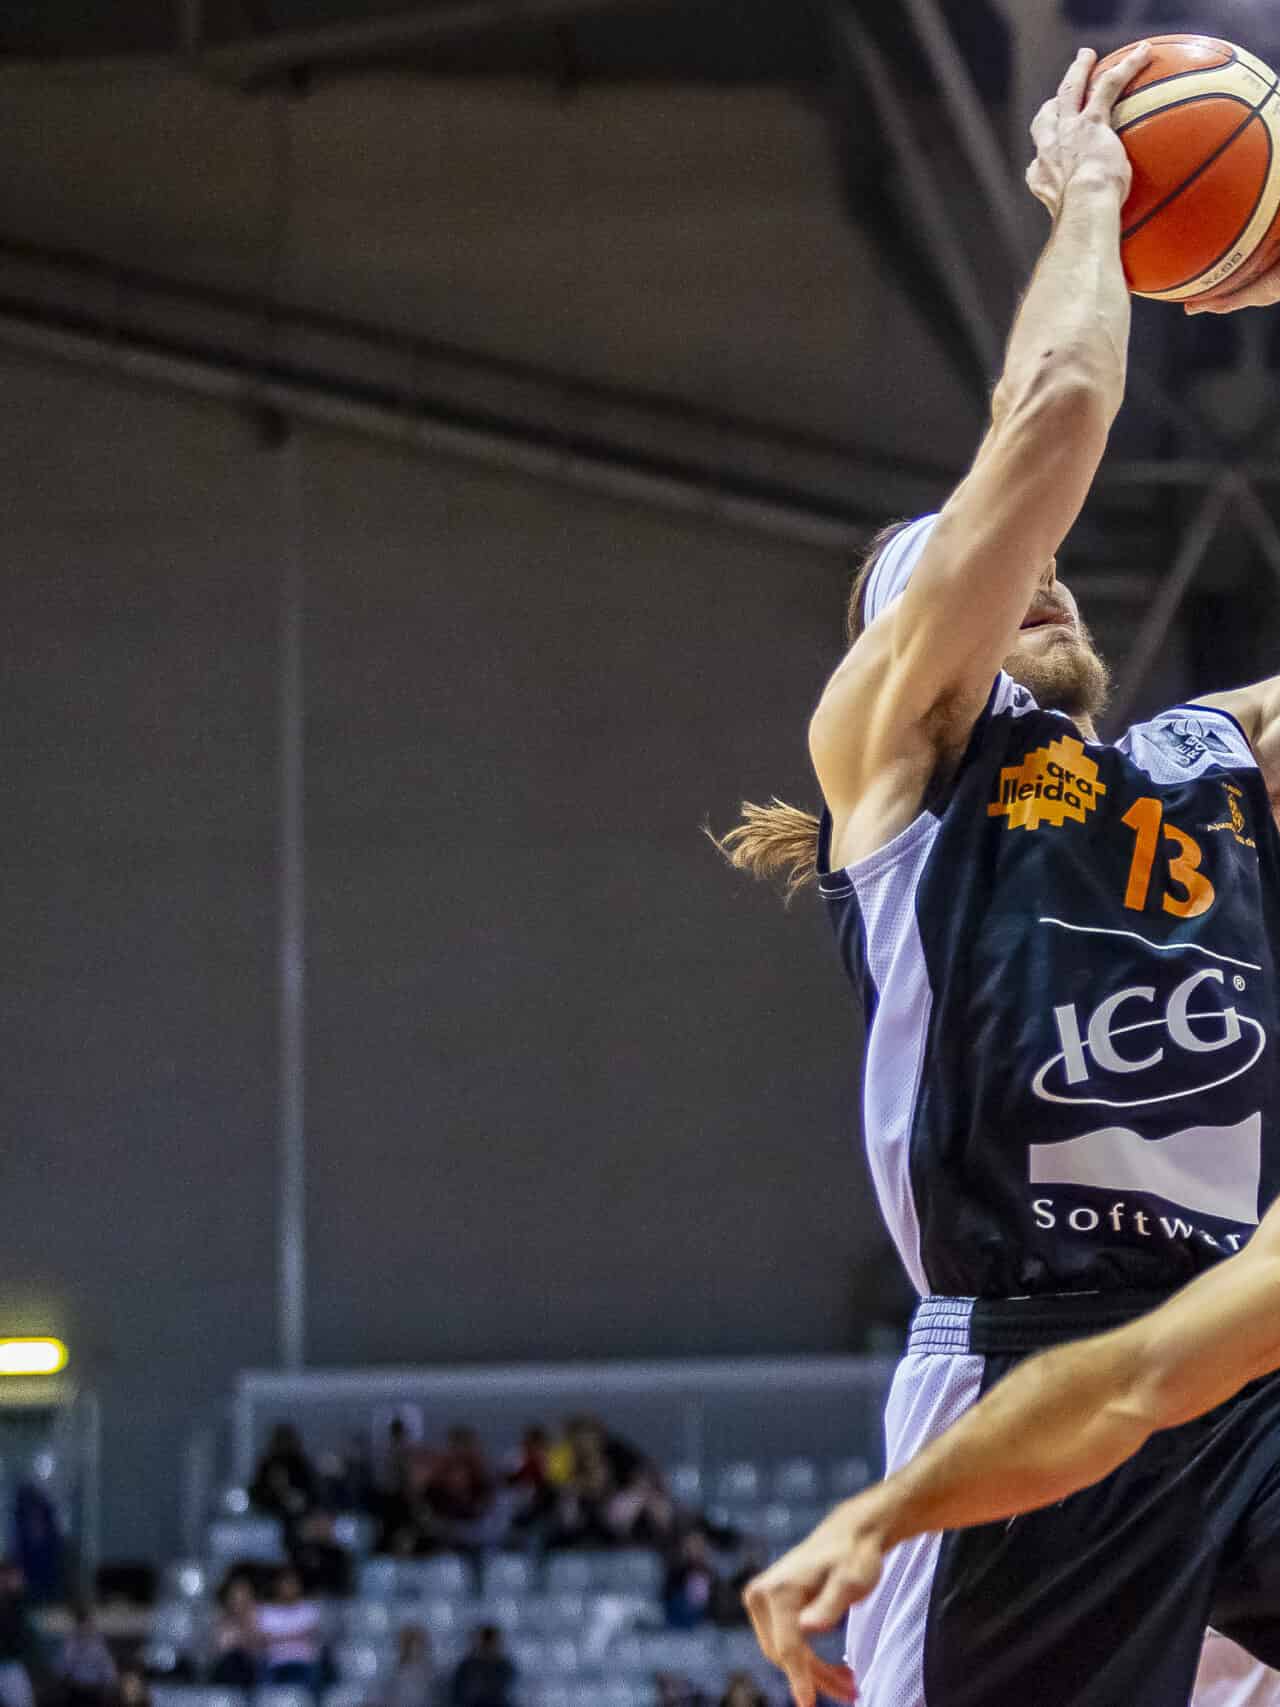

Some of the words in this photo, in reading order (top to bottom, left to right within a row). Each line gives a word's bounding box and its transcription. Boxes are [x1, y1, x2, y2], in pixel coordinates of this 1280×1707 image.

[1001, 775, 1081, 811] lleida
[1046, 760, 1093, 797] ara
[1120, 796, 1215, 919] 13
[1054, 968, 1242, 1085] ICG
[1031, 1199, 1242, 1251] Softwr
